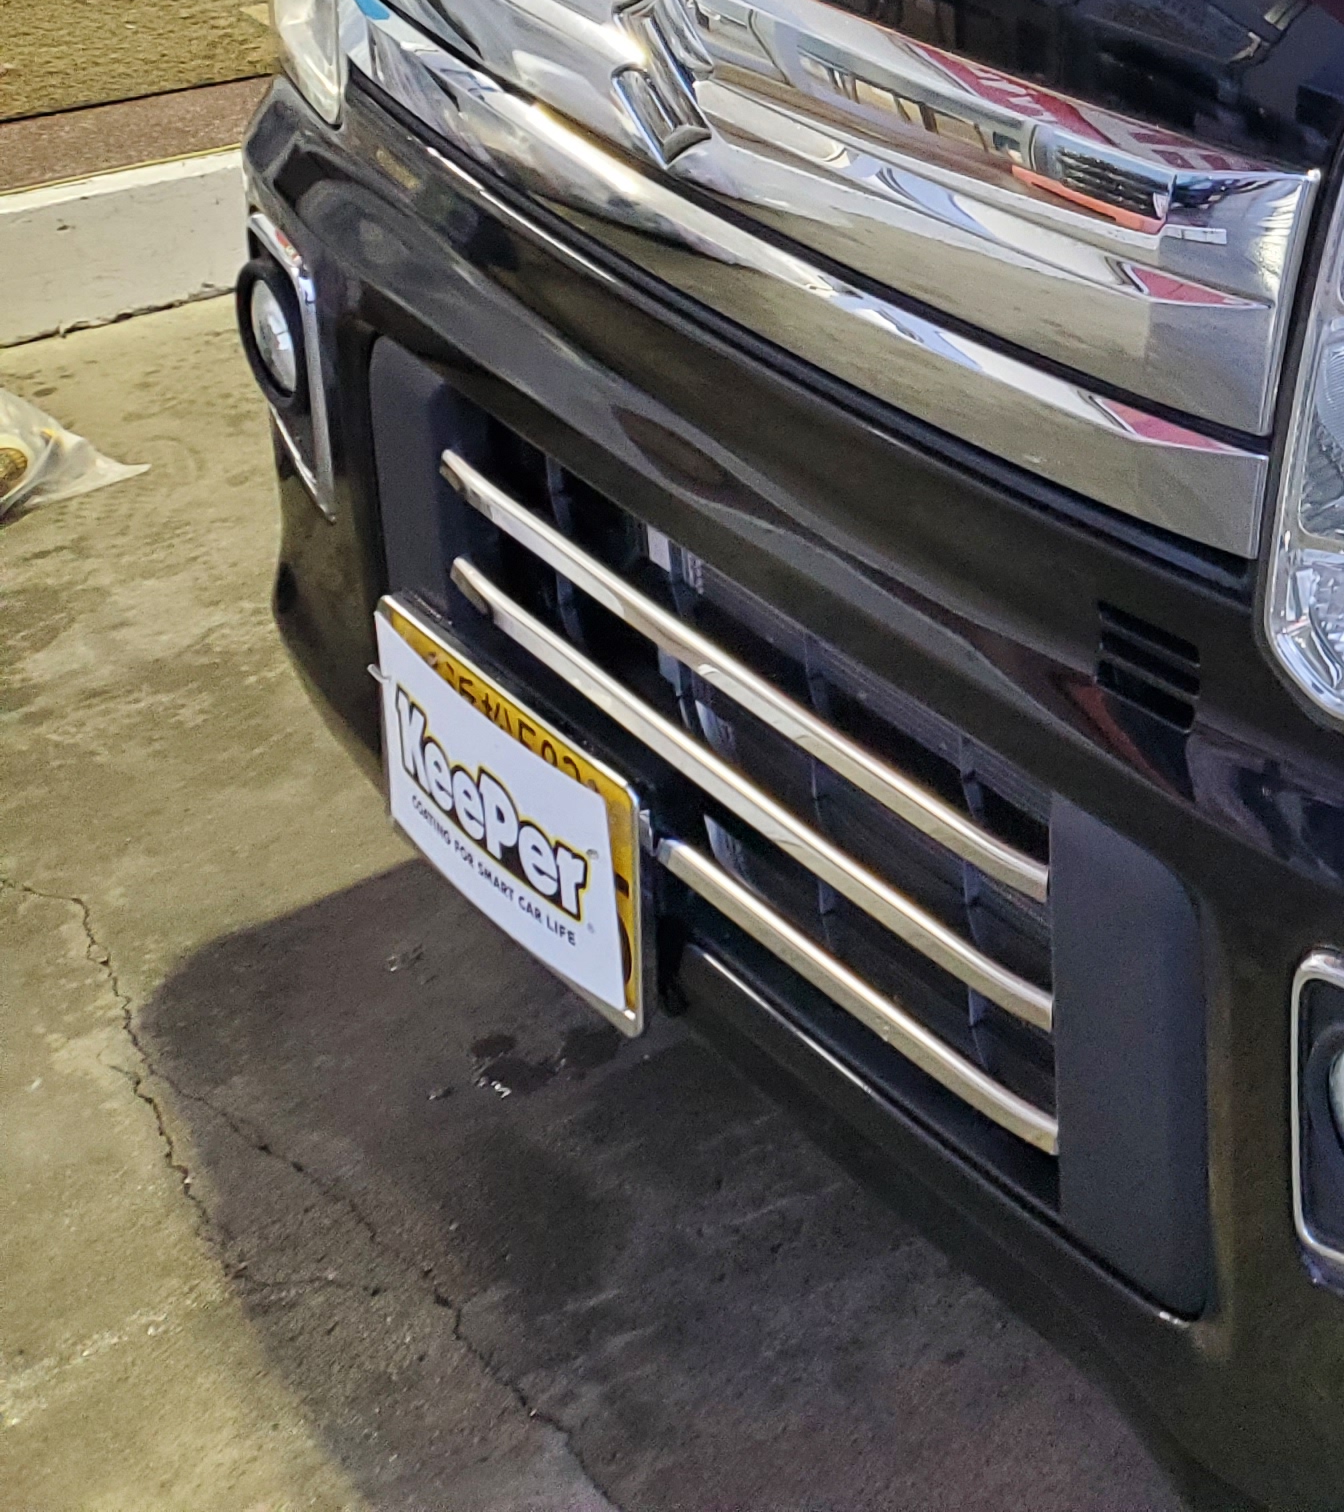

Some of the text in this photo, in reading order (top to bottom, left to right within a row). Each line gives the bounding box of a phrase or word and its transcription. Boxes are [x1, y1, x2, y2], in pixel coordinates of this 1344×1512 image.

[396, 686, 588, 920] KeePer
[411, 795, 576, 946] COATING FOR SMART CAR LIFE
